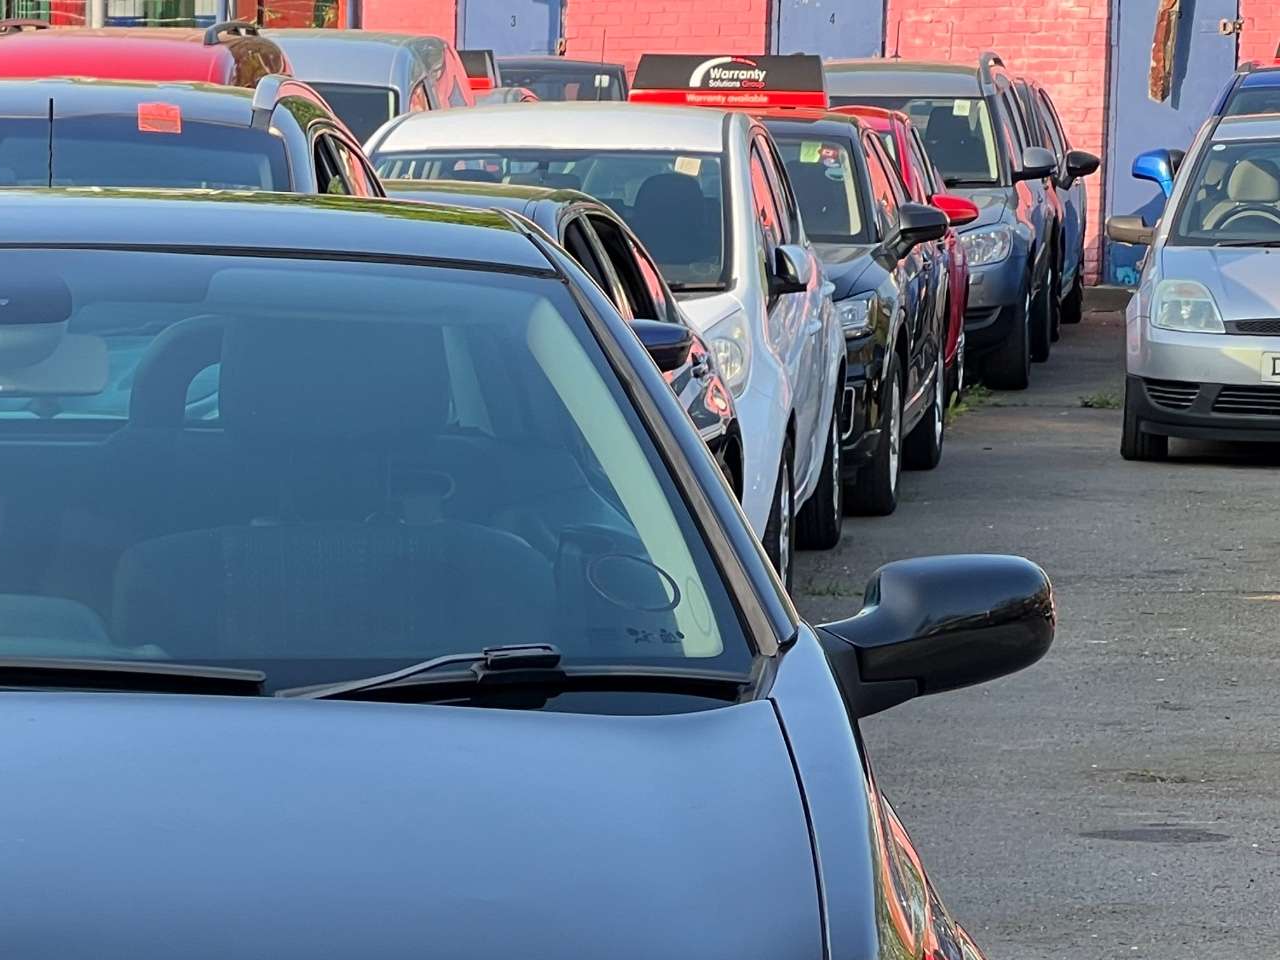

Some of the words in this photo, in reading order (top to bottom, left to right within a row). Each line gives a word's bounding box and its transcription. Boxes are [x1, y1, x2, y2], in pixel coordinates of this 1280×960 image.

[710, 67, 766, 82] Warranty
[709, 80, 740, 88] Solutions
[741, 80, 765, 88] Group
[686, 93, 726, 104] Warranty
